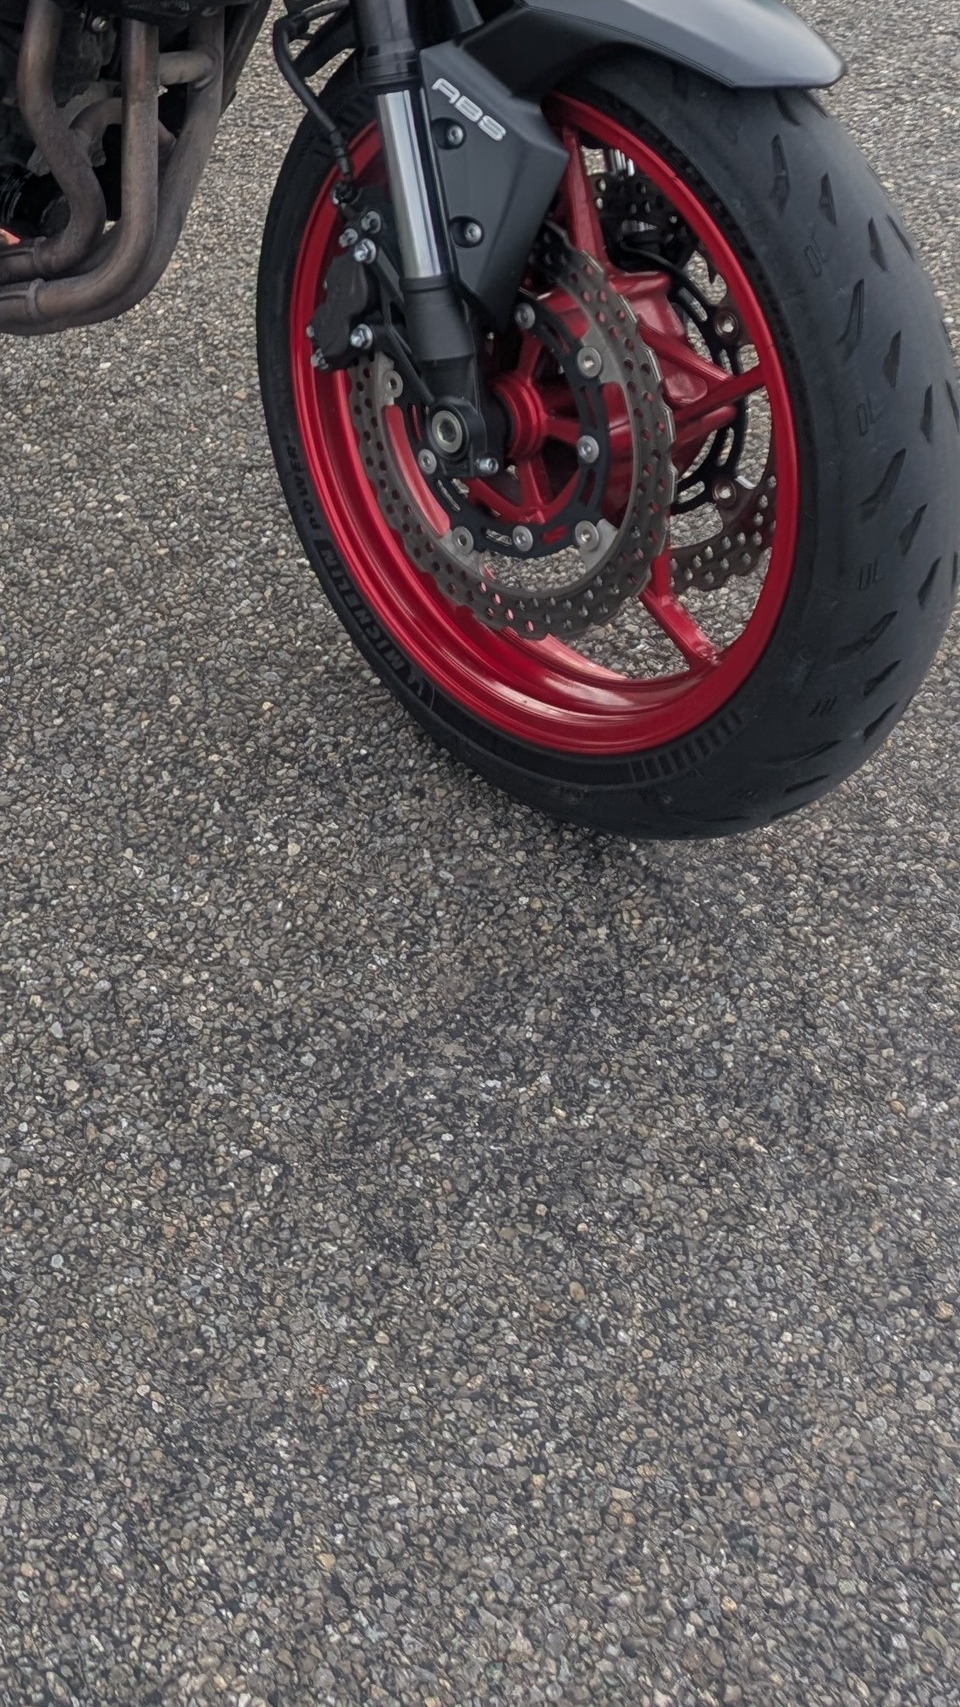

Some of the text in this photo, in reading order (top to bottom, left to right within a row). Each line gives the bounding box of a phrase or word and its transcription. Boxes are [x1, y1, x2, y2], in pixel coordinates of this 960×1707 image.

[431, 77, 507, 142] ABS
[286, 445, 407, 671] MICHELIN POWER
